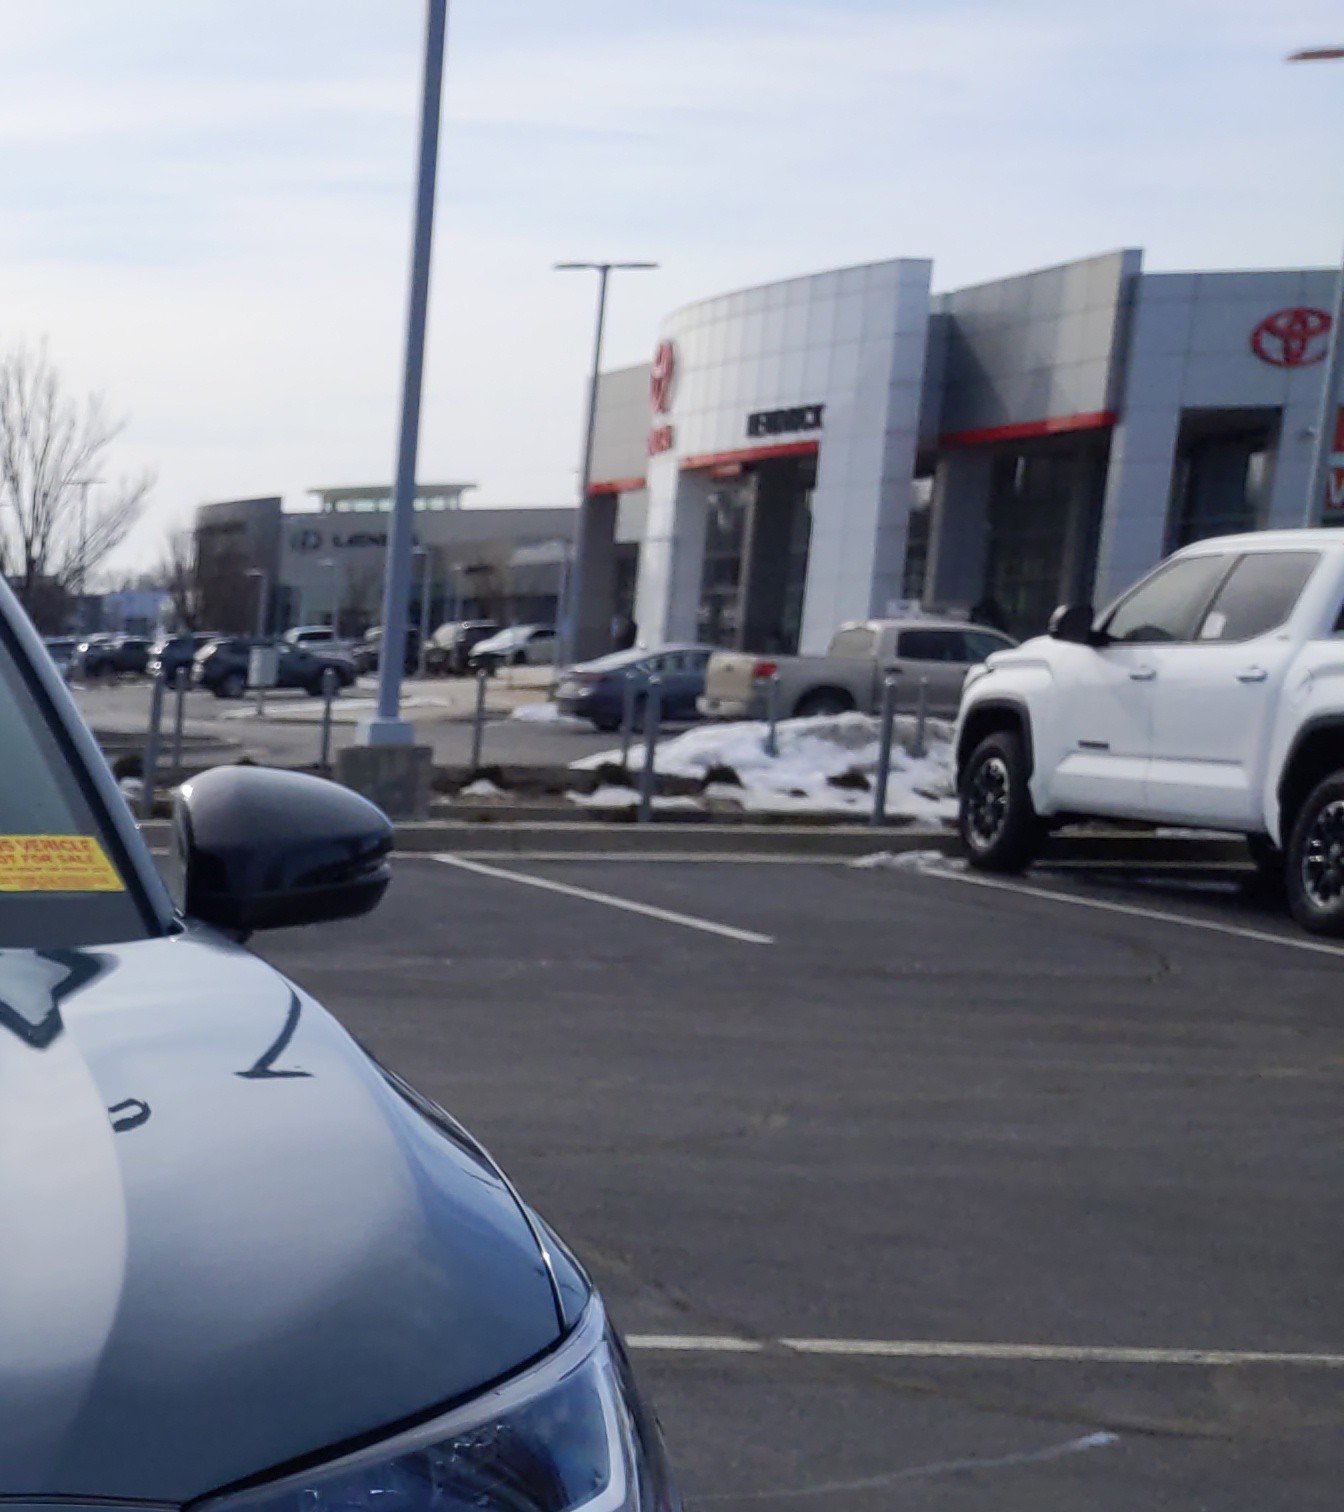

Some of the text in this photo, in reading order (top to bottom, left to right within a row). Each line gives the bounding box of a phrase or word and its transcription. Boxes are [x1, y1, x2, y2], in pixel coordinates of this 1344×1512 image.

[15, 839, 92, 852] VEHICLE
[21, 853, 52, 864] FOR
[56, 853, 95, 864] SALE
